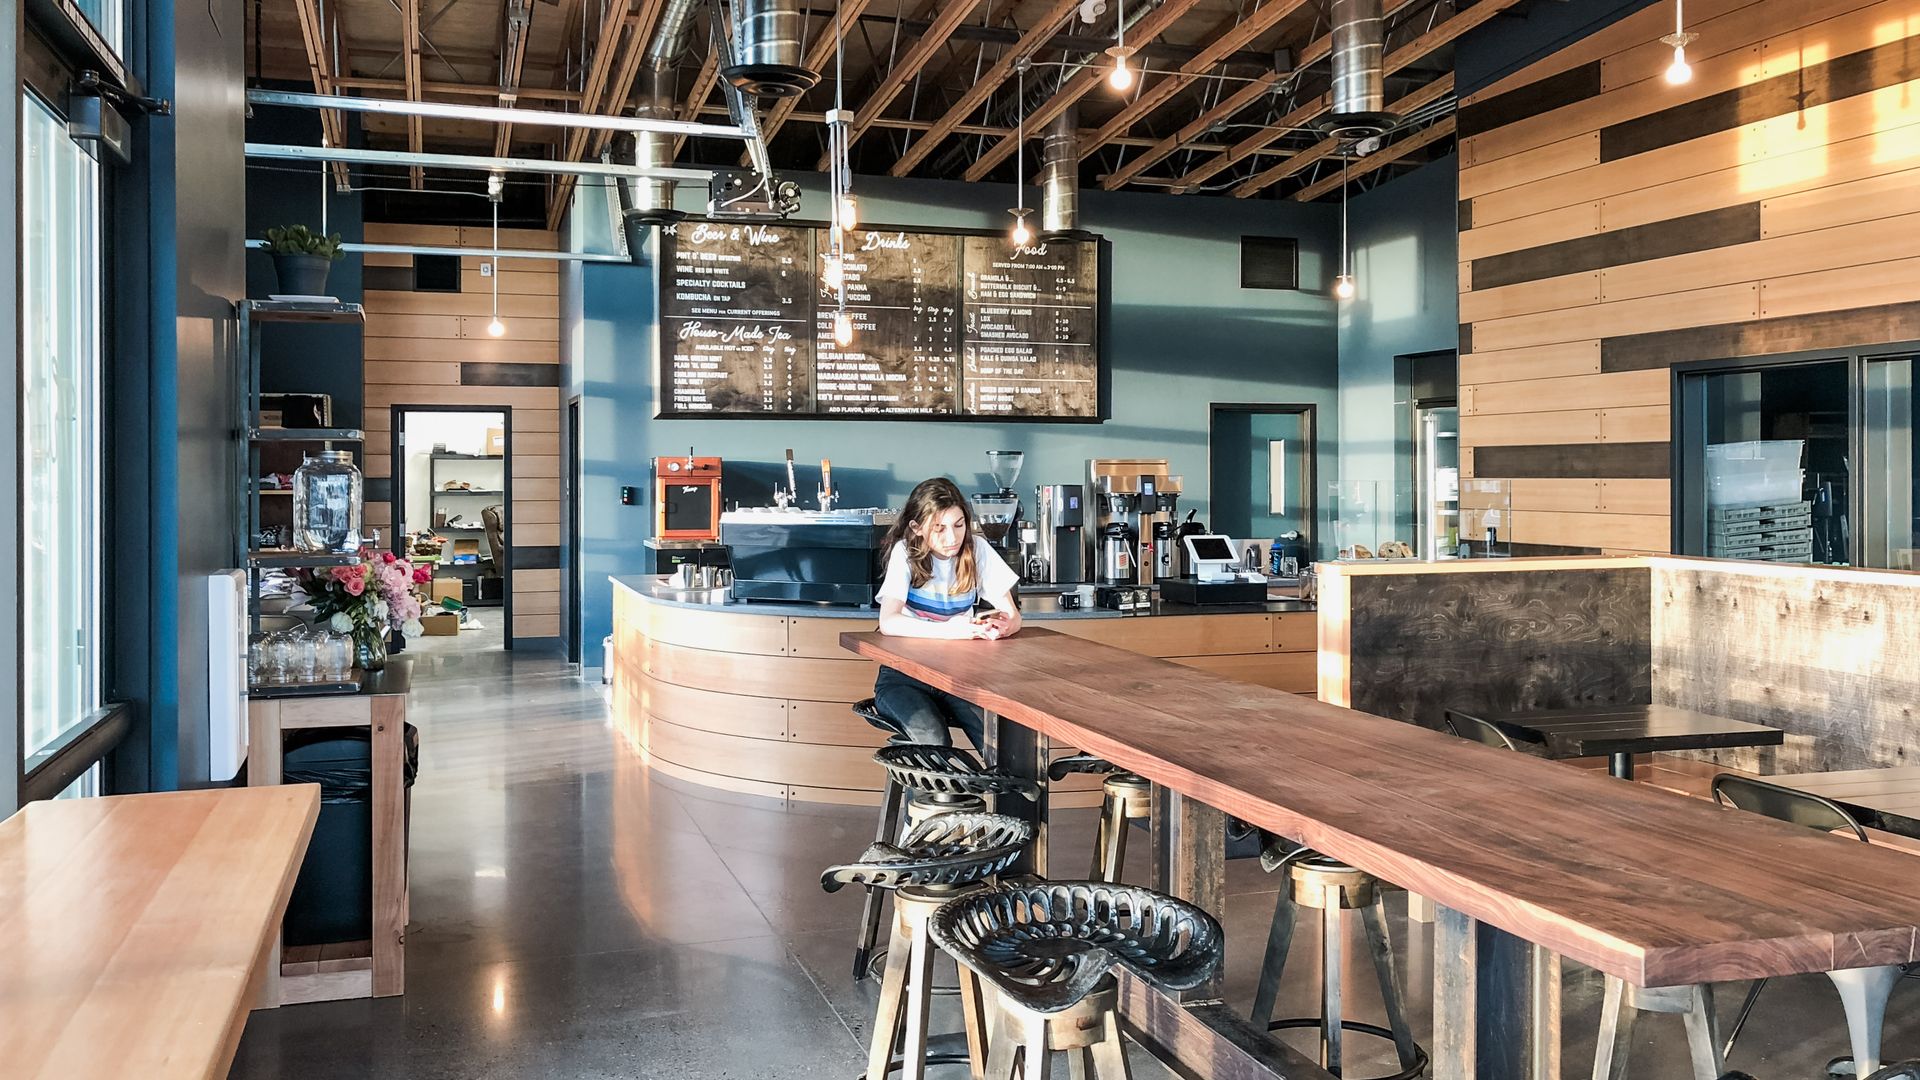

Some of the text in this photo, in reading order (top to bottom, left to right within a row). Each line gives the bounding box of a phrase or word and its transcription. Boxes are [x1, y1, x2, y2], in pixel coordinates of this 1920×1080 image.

[691, 224, 780, 246] Beer & Wine
[861, 232, 910, 251] Drinks
[680, 321, 791, 344] House-Made Tea
[817, 342, 836, 350] LATTE
